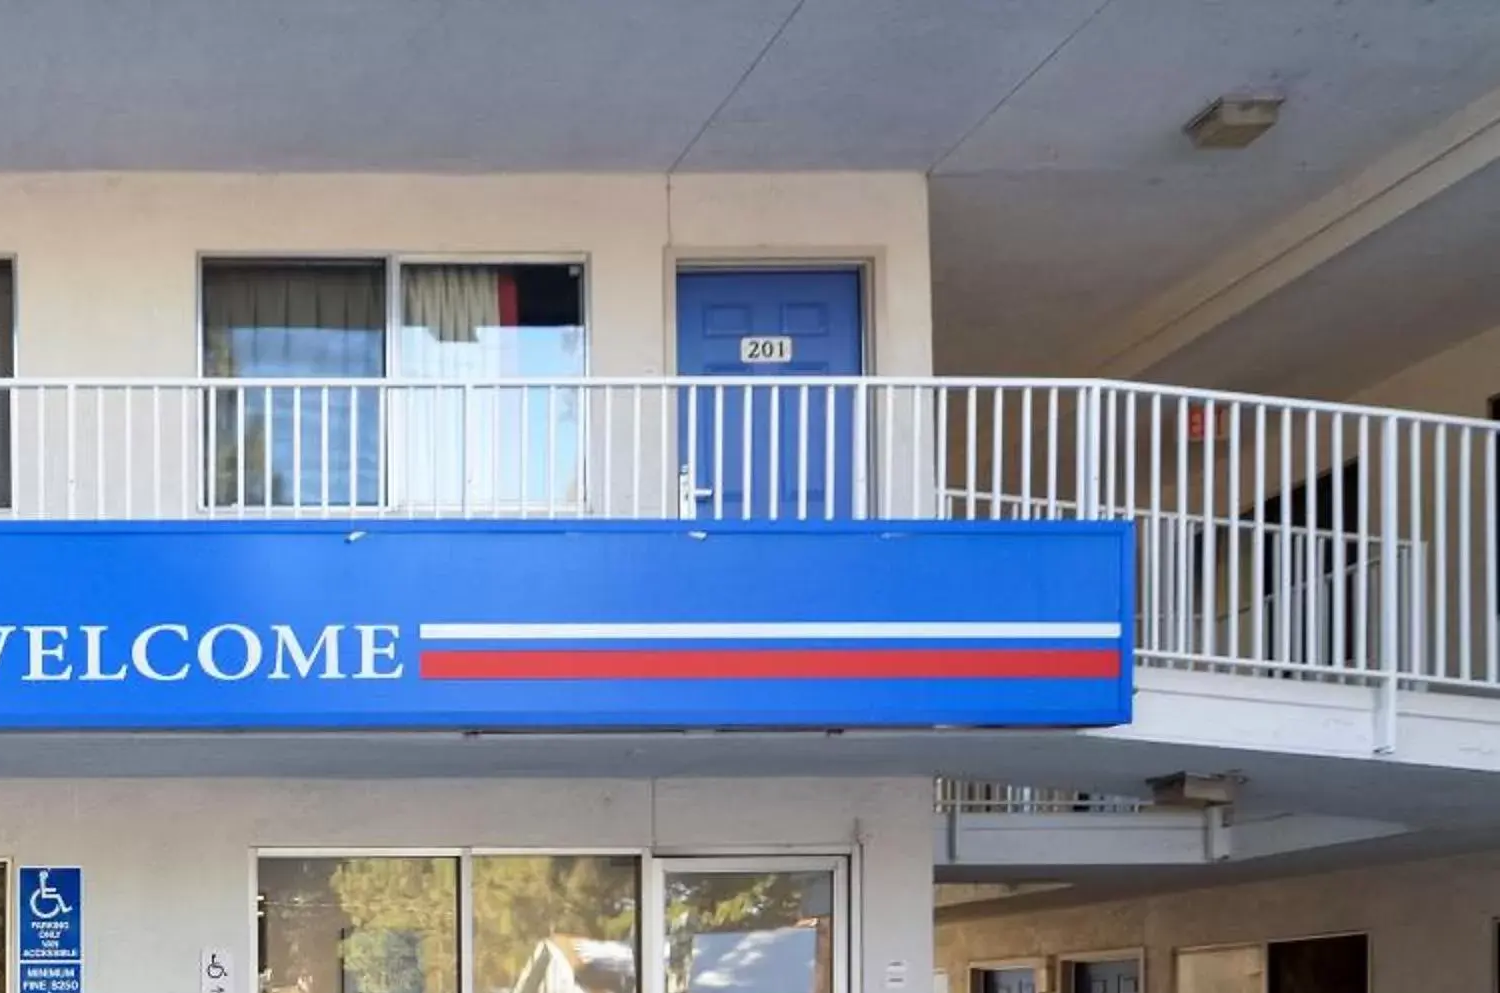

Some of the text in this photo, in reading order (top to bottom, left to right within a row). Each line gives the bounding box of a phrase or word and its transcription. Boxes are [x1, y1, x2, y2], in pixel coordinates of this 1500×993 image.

[747, 340, 784, 359] 201
[31, 920, 69, 929] PARKING
[38, 931, 61, 939] ONLY
[41, 940, 59, 948] VAN
[27, 967, 75, 978] MINIMUM
[23, 980, 47, 990] FINE
